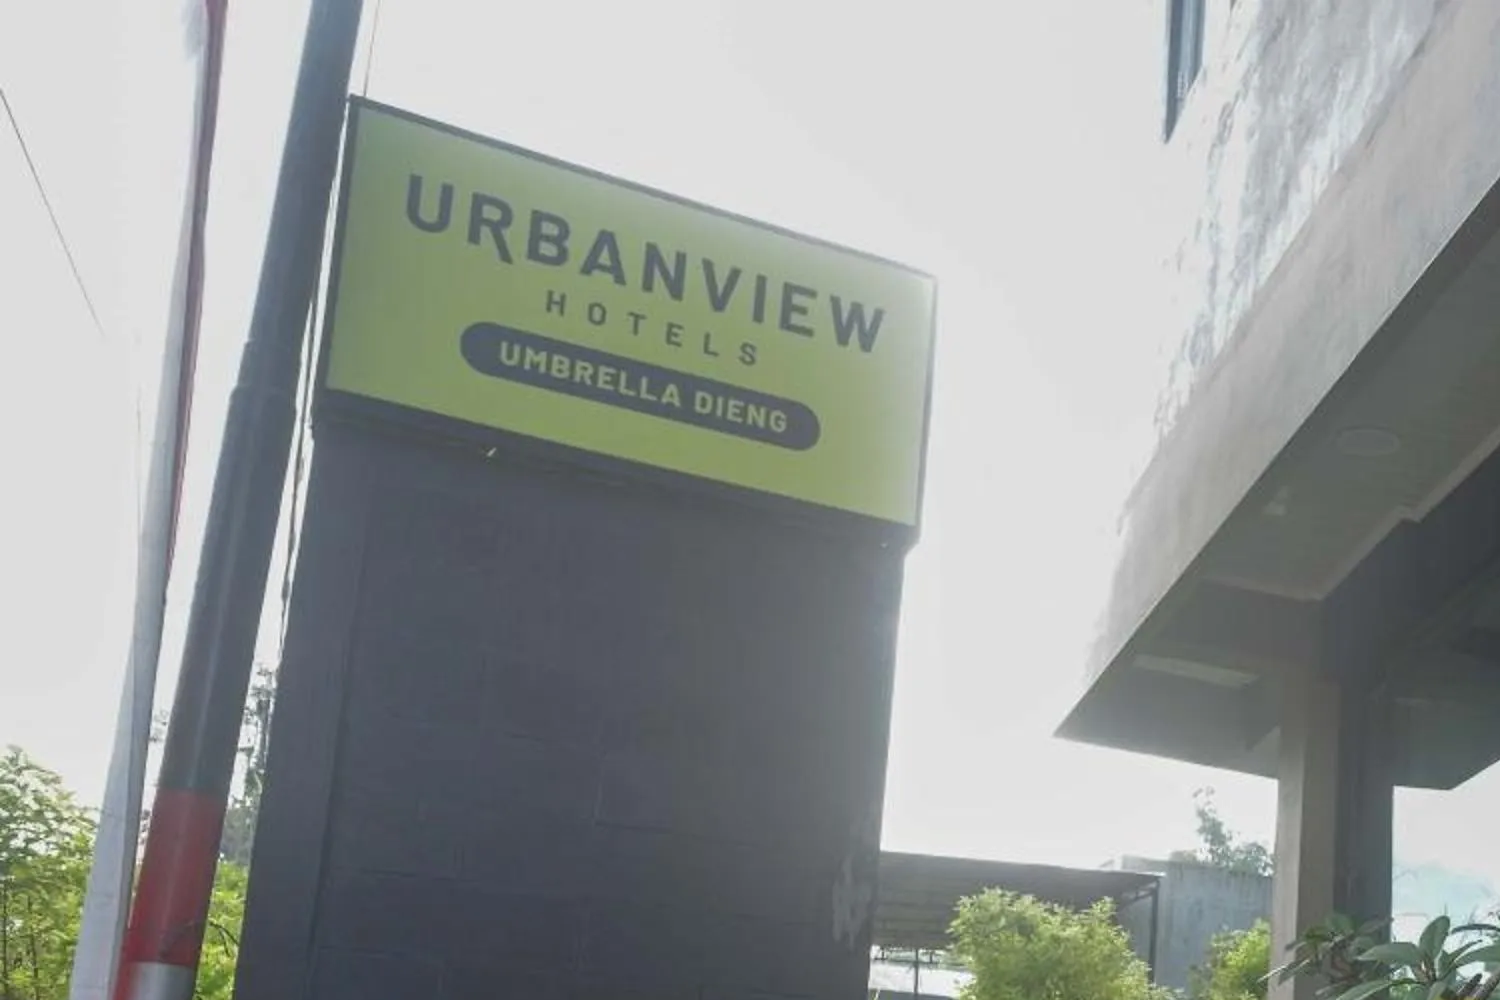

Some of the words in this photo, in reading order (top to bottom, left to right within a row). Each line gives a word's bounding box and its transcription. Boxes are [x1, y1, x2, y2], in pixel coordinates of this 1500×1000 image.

[404, 173, 887, 354] URBANVIEW
[545, 289, 759, 367] HOTELS
[499, 339, 683, 410] UMBRELLA
[693, 376, 789, 434] DIENG
